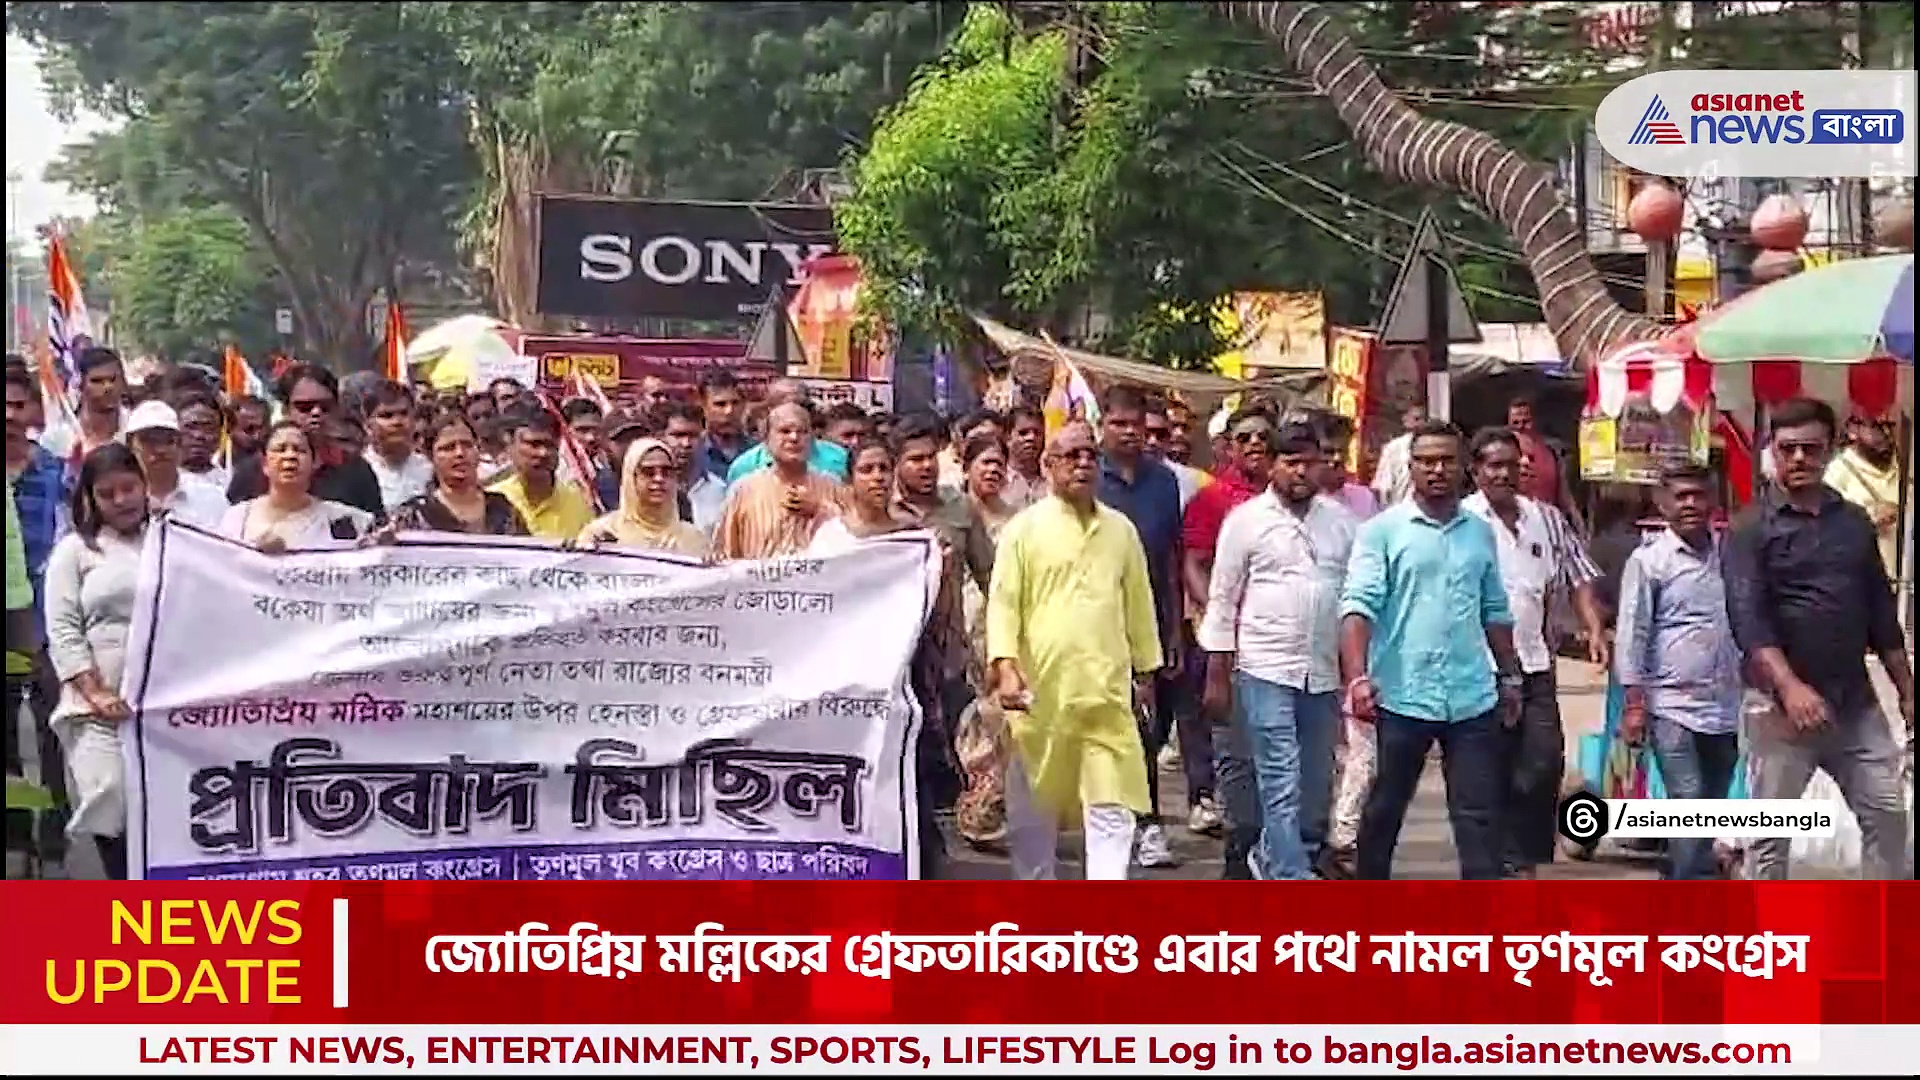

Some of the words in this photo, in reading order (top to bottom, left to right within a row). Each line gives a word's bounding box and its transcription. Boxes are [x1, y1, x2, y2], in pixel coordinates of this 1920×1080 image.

[580, 233, 835, 286] SONY
[191, 738, 545, 854] প্রতিবাদ
[565, 737, 872, 832] মিছিল
